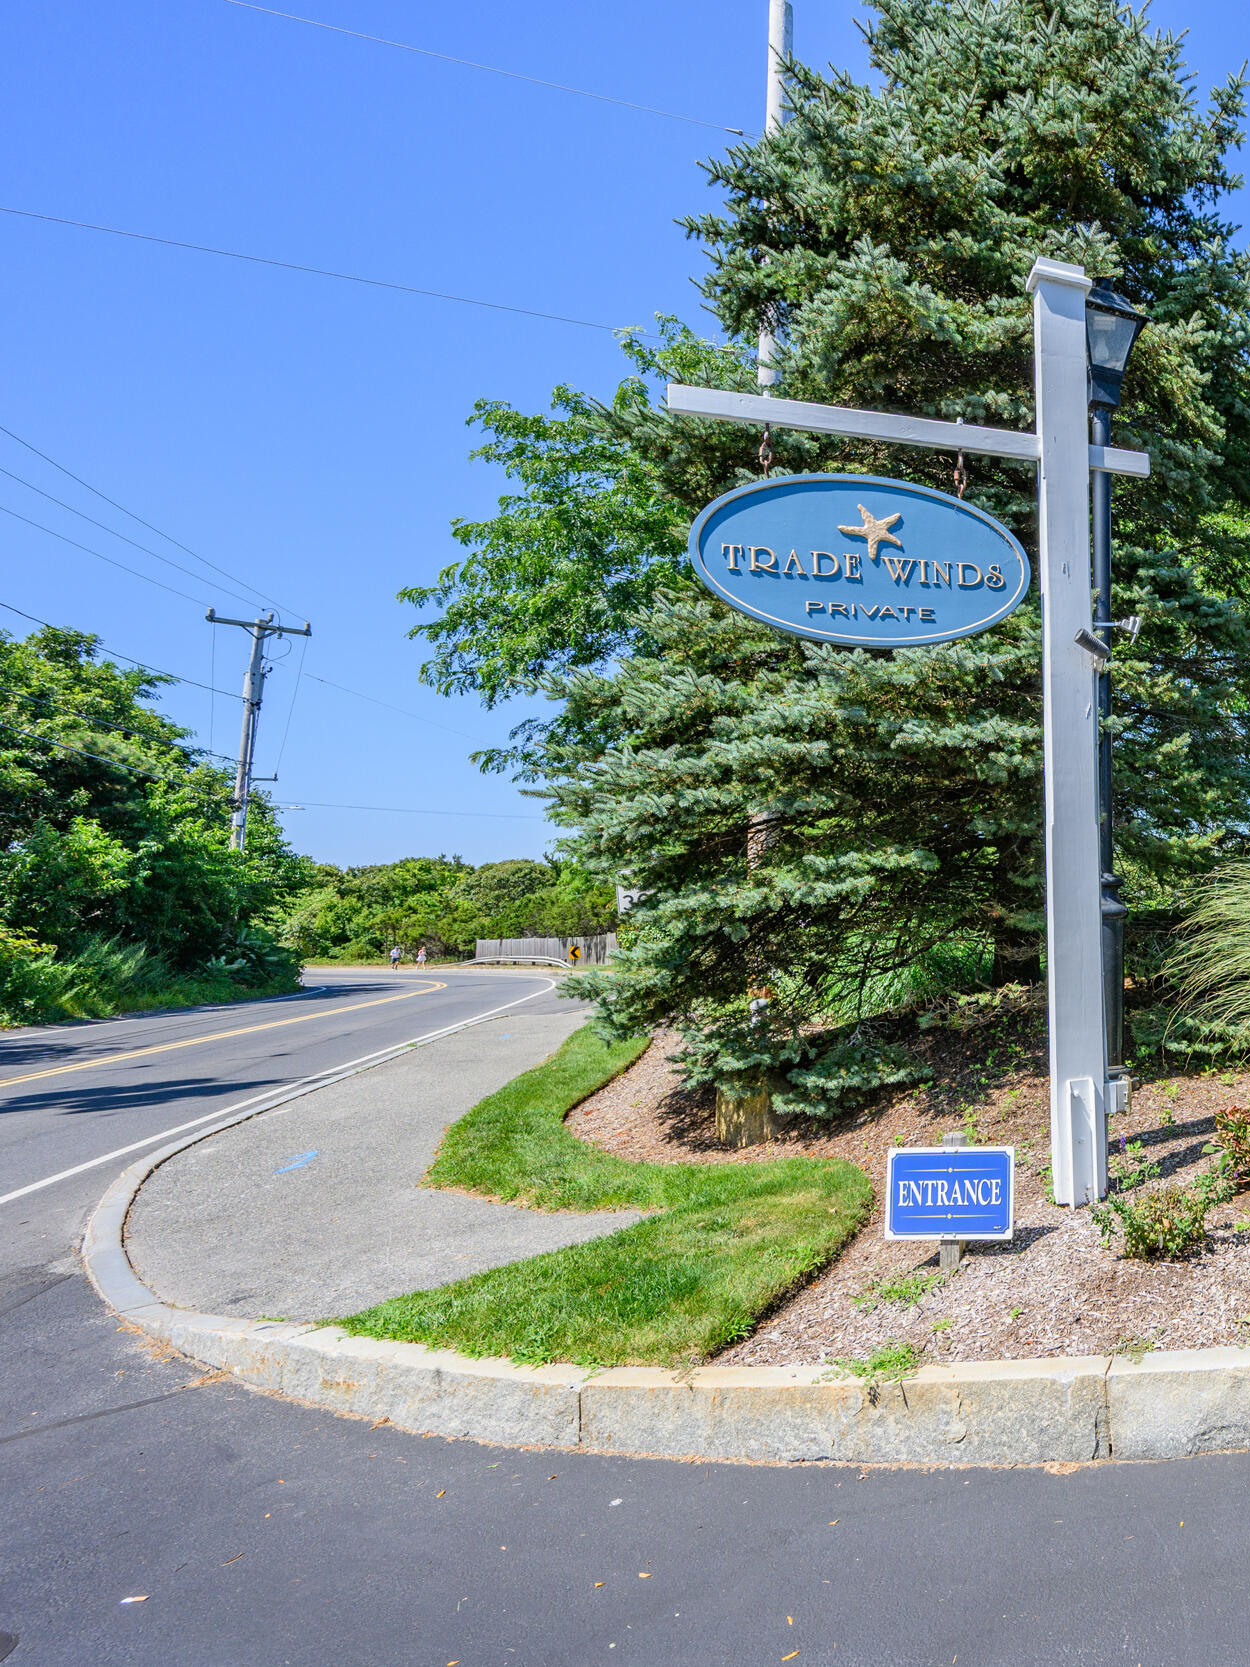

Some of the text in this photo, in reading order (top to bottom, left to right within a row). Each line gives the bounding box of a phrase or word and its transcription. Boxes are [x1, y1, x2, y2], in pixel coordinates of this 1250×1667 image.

[721, 542, 1006, 589] TRADE WINDS
[805, 600, 936, 620] PRIVATE
[898, 1178, 1002, 1207] ENTRANCE
